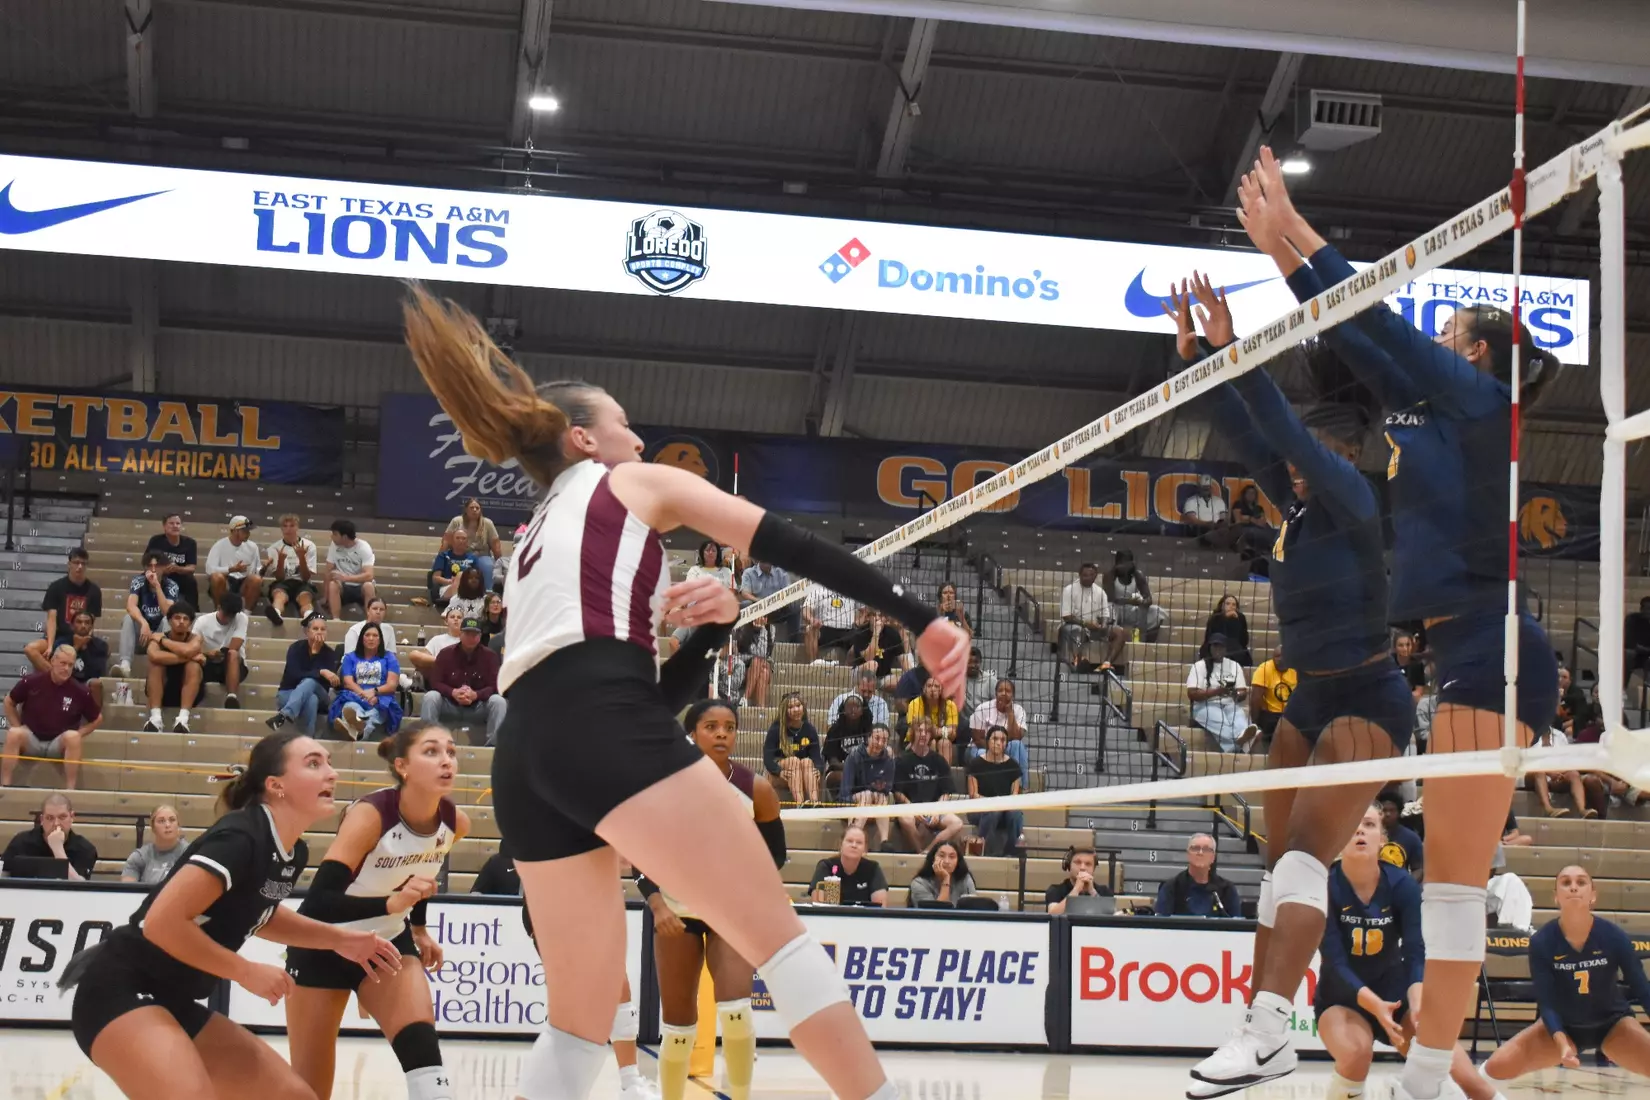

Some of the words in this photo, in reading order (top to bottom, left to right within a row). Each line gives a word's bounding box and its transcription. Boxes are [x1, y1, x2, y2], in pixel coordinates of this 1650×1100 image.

[253, 190, 328, 210] EAST
[340, 197, 434, 219] TEXAS
[446, 205, 510, 225] A&M
[1423, 232, 1448, 256] EAST
[1451, 207, 1484, 240] TEXAS
[1488, 191, 1511, 221] A&M
[253, 208, 509, 268] LIONS
[631, 235, 703, 261] LOREDO
[631, 259, 662, 271] SPORTS
[664, 260, 703, 275] COMPLEX
[878, 259, 1059, 301] Domino's
[1325, 285, 1347, 310] EAST
[1348, 269, 1377, 297] TEXAS
[1378, 257, 1397, 286] A&M
[1427, 281, 1508, 303] TEXAS
[1519, 289, 1574, 307] A&M
[1242, 332, 1263, 355] EAST
[1264, 319, 1286, 345] TEXAS
[1174, 374, 1190, 394] EAST
[1191, 361, 1211, 384] TEXAS
[64, 443, 261, 480] ALL-AMERICANS
[876, 455, 1021, 514] GO
[1062, 466, 1284, 530] LION
[375, 853, 422, 869] SOUTHERN
[1340, 914, 1362, 925] EAST
[1487, 937, 1530, 948] LIONS
[424, 951, 547, 996] egiona
[843, 946, 931, 982] BEST
[935, 949, 1040, 985] PLACE
[1553, 962, 1576, 971] EAST
[1578, 957, 1608, 969] TEXAS
[1573, 970, 1590, 995] 7
[432, 988, 548, 1025] ealthc
[847, 984, 887, 1019] TO
[894, 986, 987, 1021] STAY!
